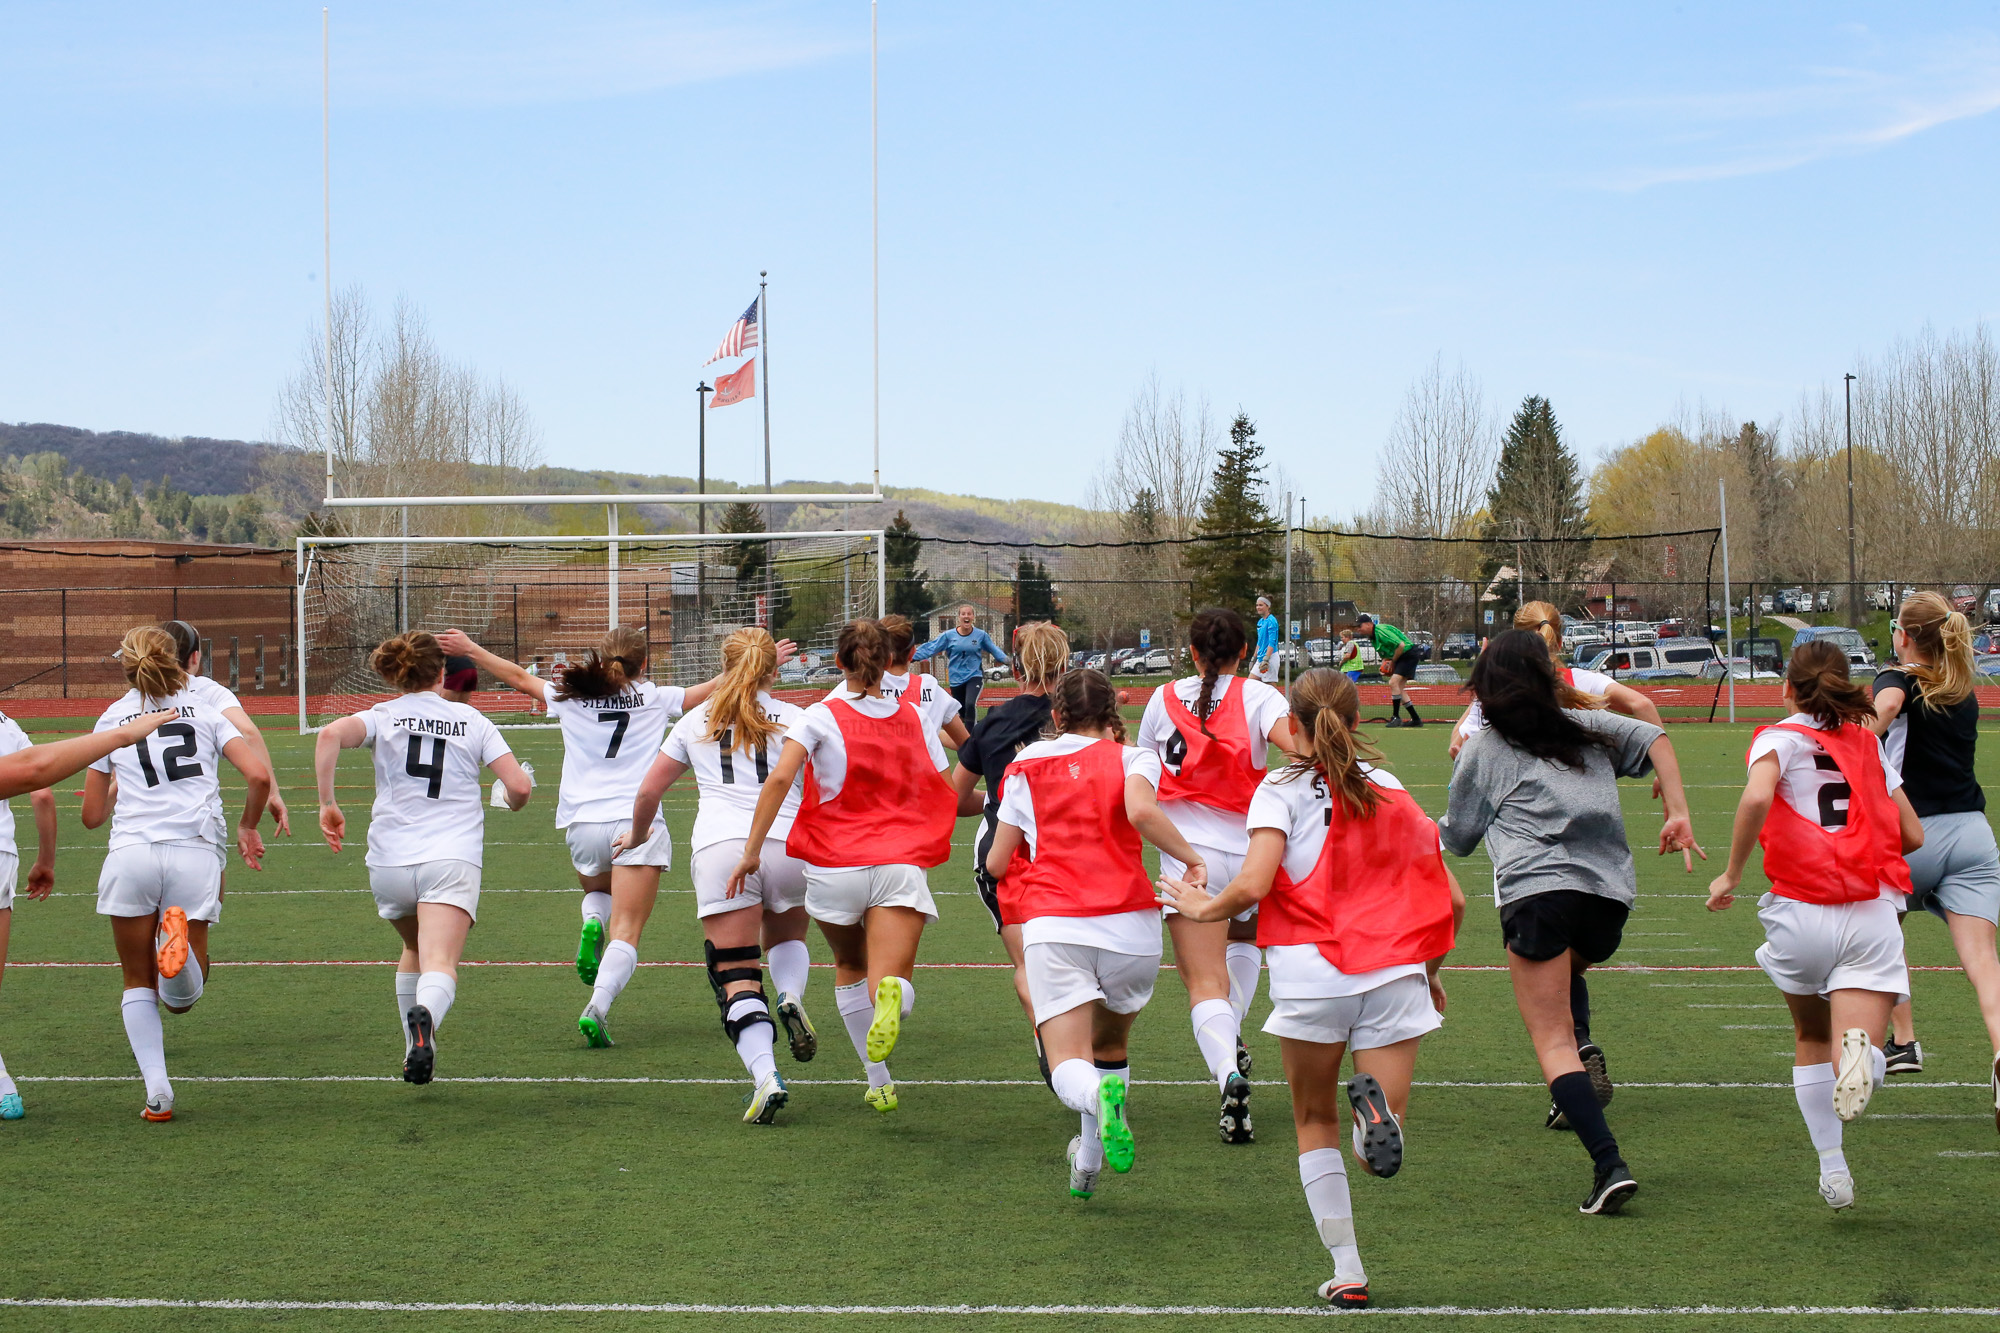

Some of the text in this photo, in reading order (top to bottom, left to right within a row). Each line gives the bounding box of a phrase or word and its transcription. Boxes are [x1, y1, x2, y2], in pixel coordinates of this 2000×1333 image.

[582, 693, 645, 709] STEAMBOAT
[393, 717, 468, 737] STEAMBOAT
[597, 711, 631, 759] 7
[135, 722, 205, 788] 12
[405, 734, 447, 799] 4
[713, 729, 769, 784] 11
